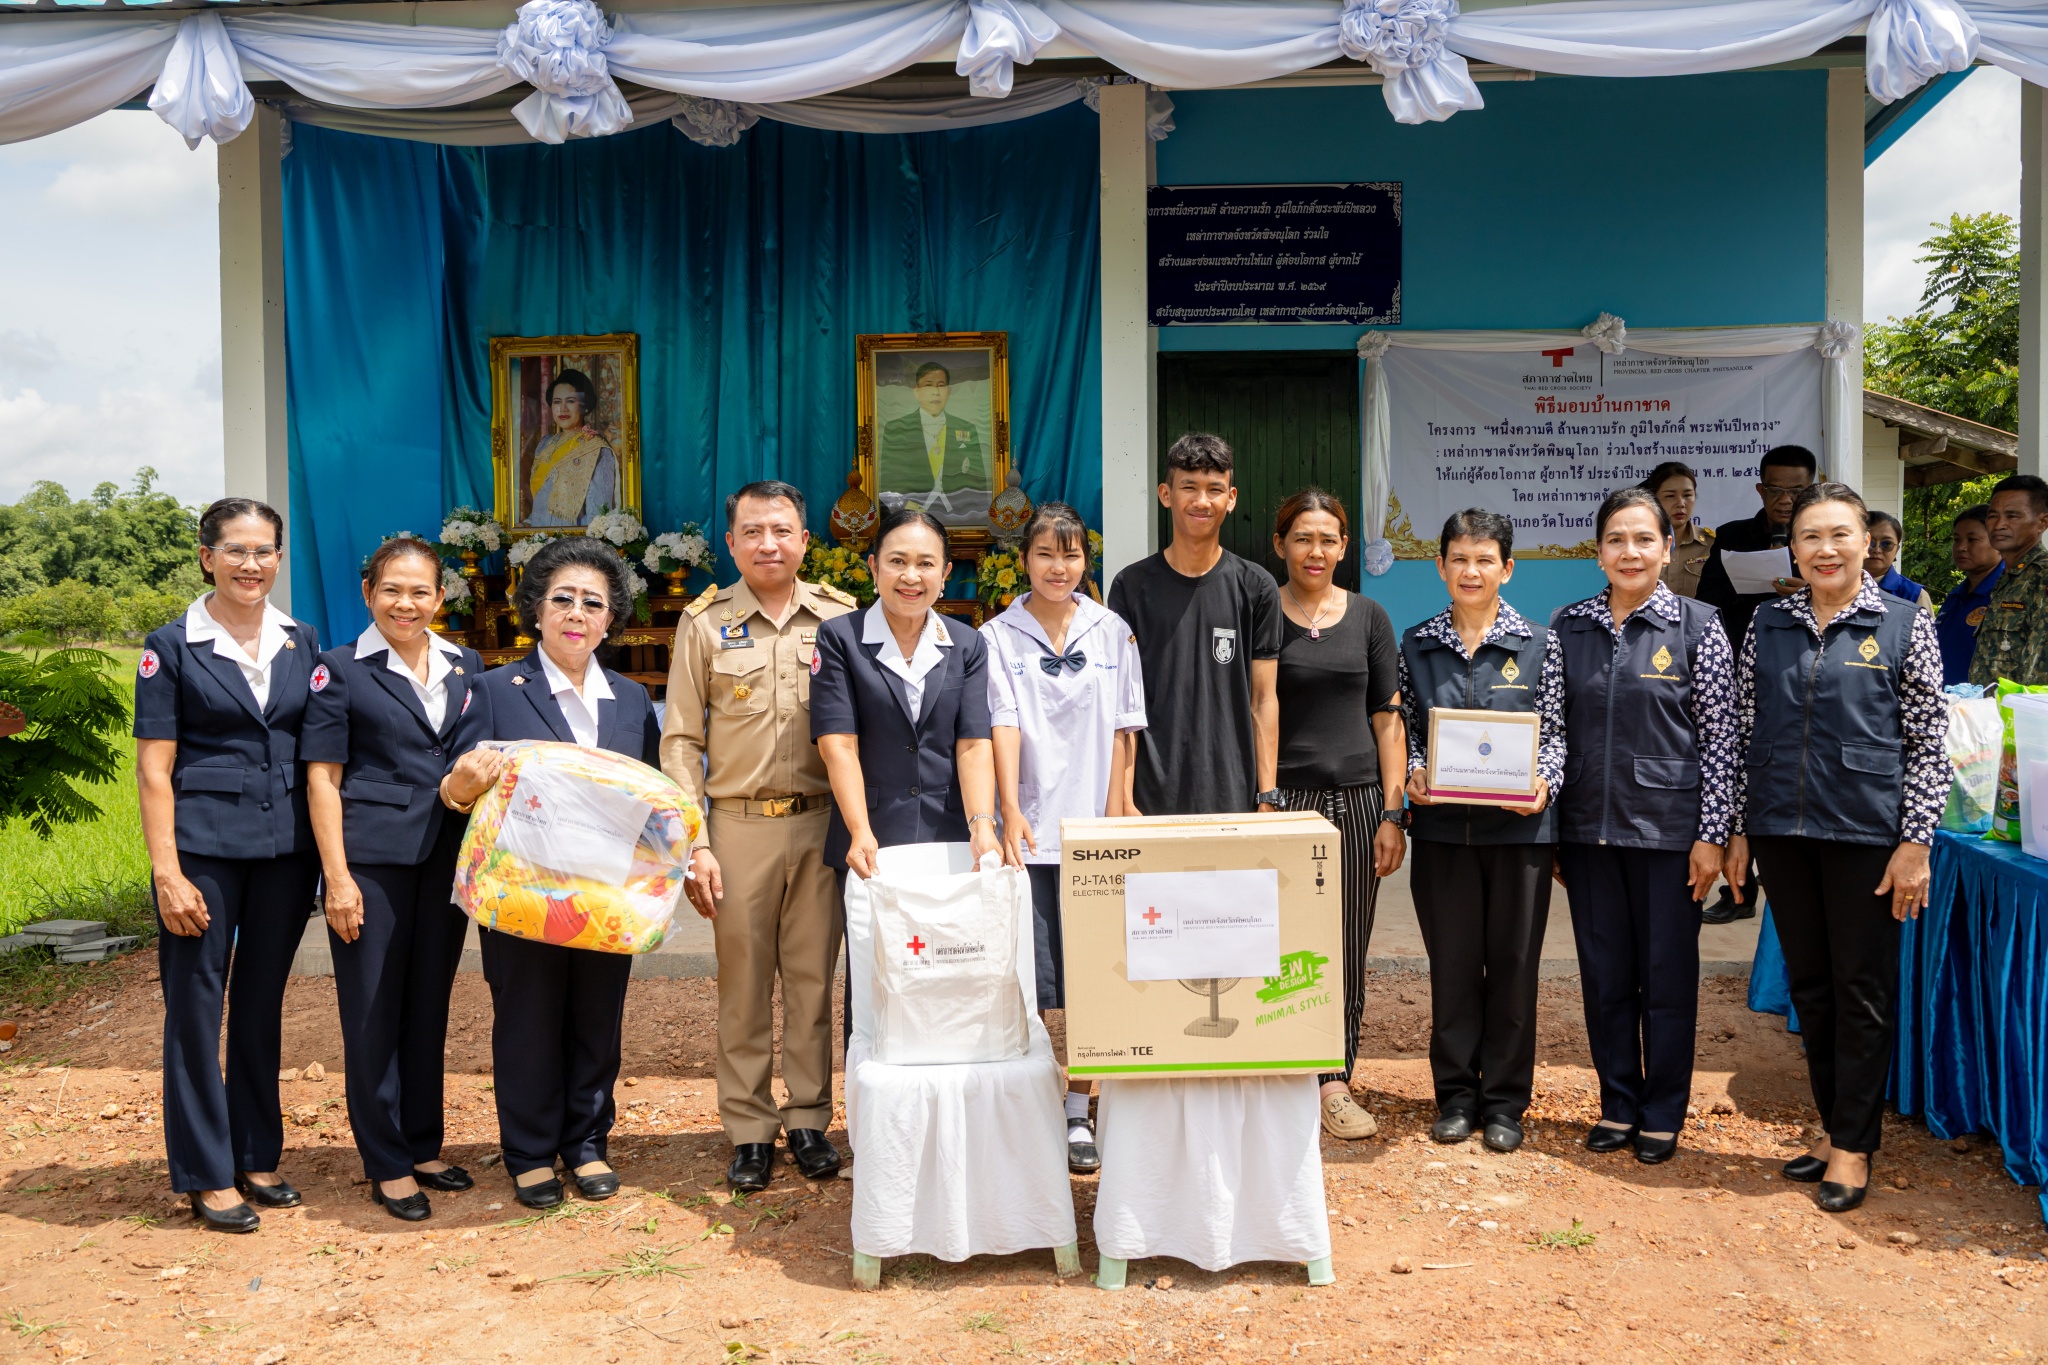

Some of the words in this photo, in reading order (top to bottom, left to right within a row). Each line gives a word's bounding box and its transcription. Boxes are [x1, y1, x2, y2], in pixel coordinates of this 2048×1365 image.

[1186, 226, 1300, 243] เหล่ากาชาดจังหวัดพิษณุโลก
[1303, 226, 1330, 240] ร่วมใจ
[1194, 279, 1275, 292] ประจำปีงบประมาณ
[1155, 303, 1256, 321] สนับสนุนงบประมาณโดย
[1259, 302, 1374, 320] เหล่ากาชาดจังหวัดพิษณุโลก
[1613, 357, 1710, 368] เหล่ากาชาดจังหวัดพิษณุโลก
[1713, 365, 1754, 373] PHITSANULOK
[1522, 371, 1593, 385] สภากาชาดไทย
[1534, 393, 1671, 414] พิธีมอบบ้านกาชาด
[1427, 422, 1476, 436] โครงการ
[1558, 420, 1626, 435] ล้านความรัก
[1630, 415, 1687, 437] ภูมิใจภักดิ์
[1443, 443, 1599, 460] เหล่ากาชาดจังหวัดพิษณุโลก
[1436, 467, 1536, 484] ให้แก่ผู้ด้อยโอกาส
[1540, 465, 1585, 483] ผู้ยากไร้
[1703, 466, 1727, 478] พ.ศ.
[1512, 488, 1534, 502] โดย
[1072, 848, 1141, 861] SHARP
[1072, 889, 1109, 897] ELECTRIC
[1279, 974, 1307, 991] DESIGN
[1255, 1004, 1297, 1027] MINIMAL
[1299, 991, 1332, 1012] STYLE
[1130, 1046, 1154, 1056] TCE
